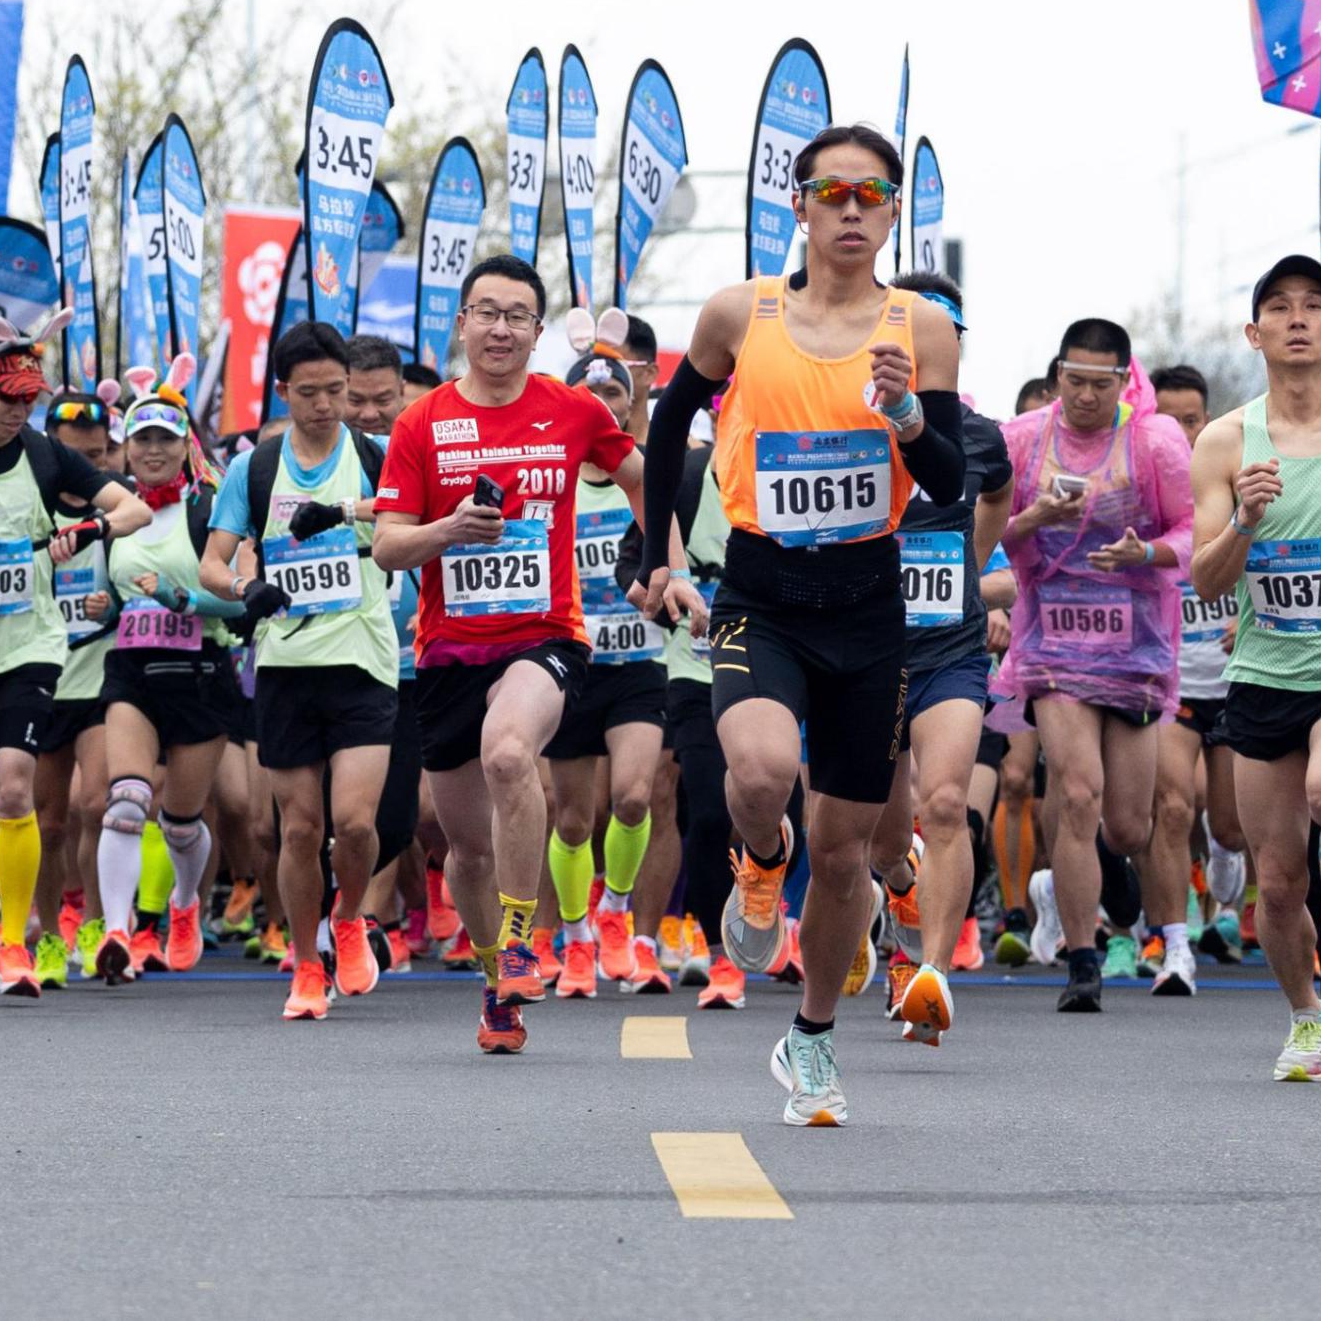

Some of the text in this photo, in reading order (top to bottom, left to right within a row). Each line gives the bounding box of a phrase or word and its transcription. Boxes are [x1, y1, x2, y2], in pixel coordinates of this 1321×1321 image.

[316, 125, 373, 178] 3:45
[629, 141, 661, 204] 6:30
[430, 234, 467, 276] 3:45
[435, 420, 475, 434] OSAKA
[437, 449, 473, 462] Making
[481, 446, 523, 458] Rainbow
[523, 443, 566, 455] Together
[517, 467, 566, 495] 2018
[769, 472, 876, 515] 10615
[272, 561, 351, 594] 10598
[449, 554, 541, 593] 10325
[902, 566, 953, 602] 016
[123, 613, 194, 639] 20195
[596, 622, 646, 651] 4:00
[1047, 607, 1124, 633] 10586
